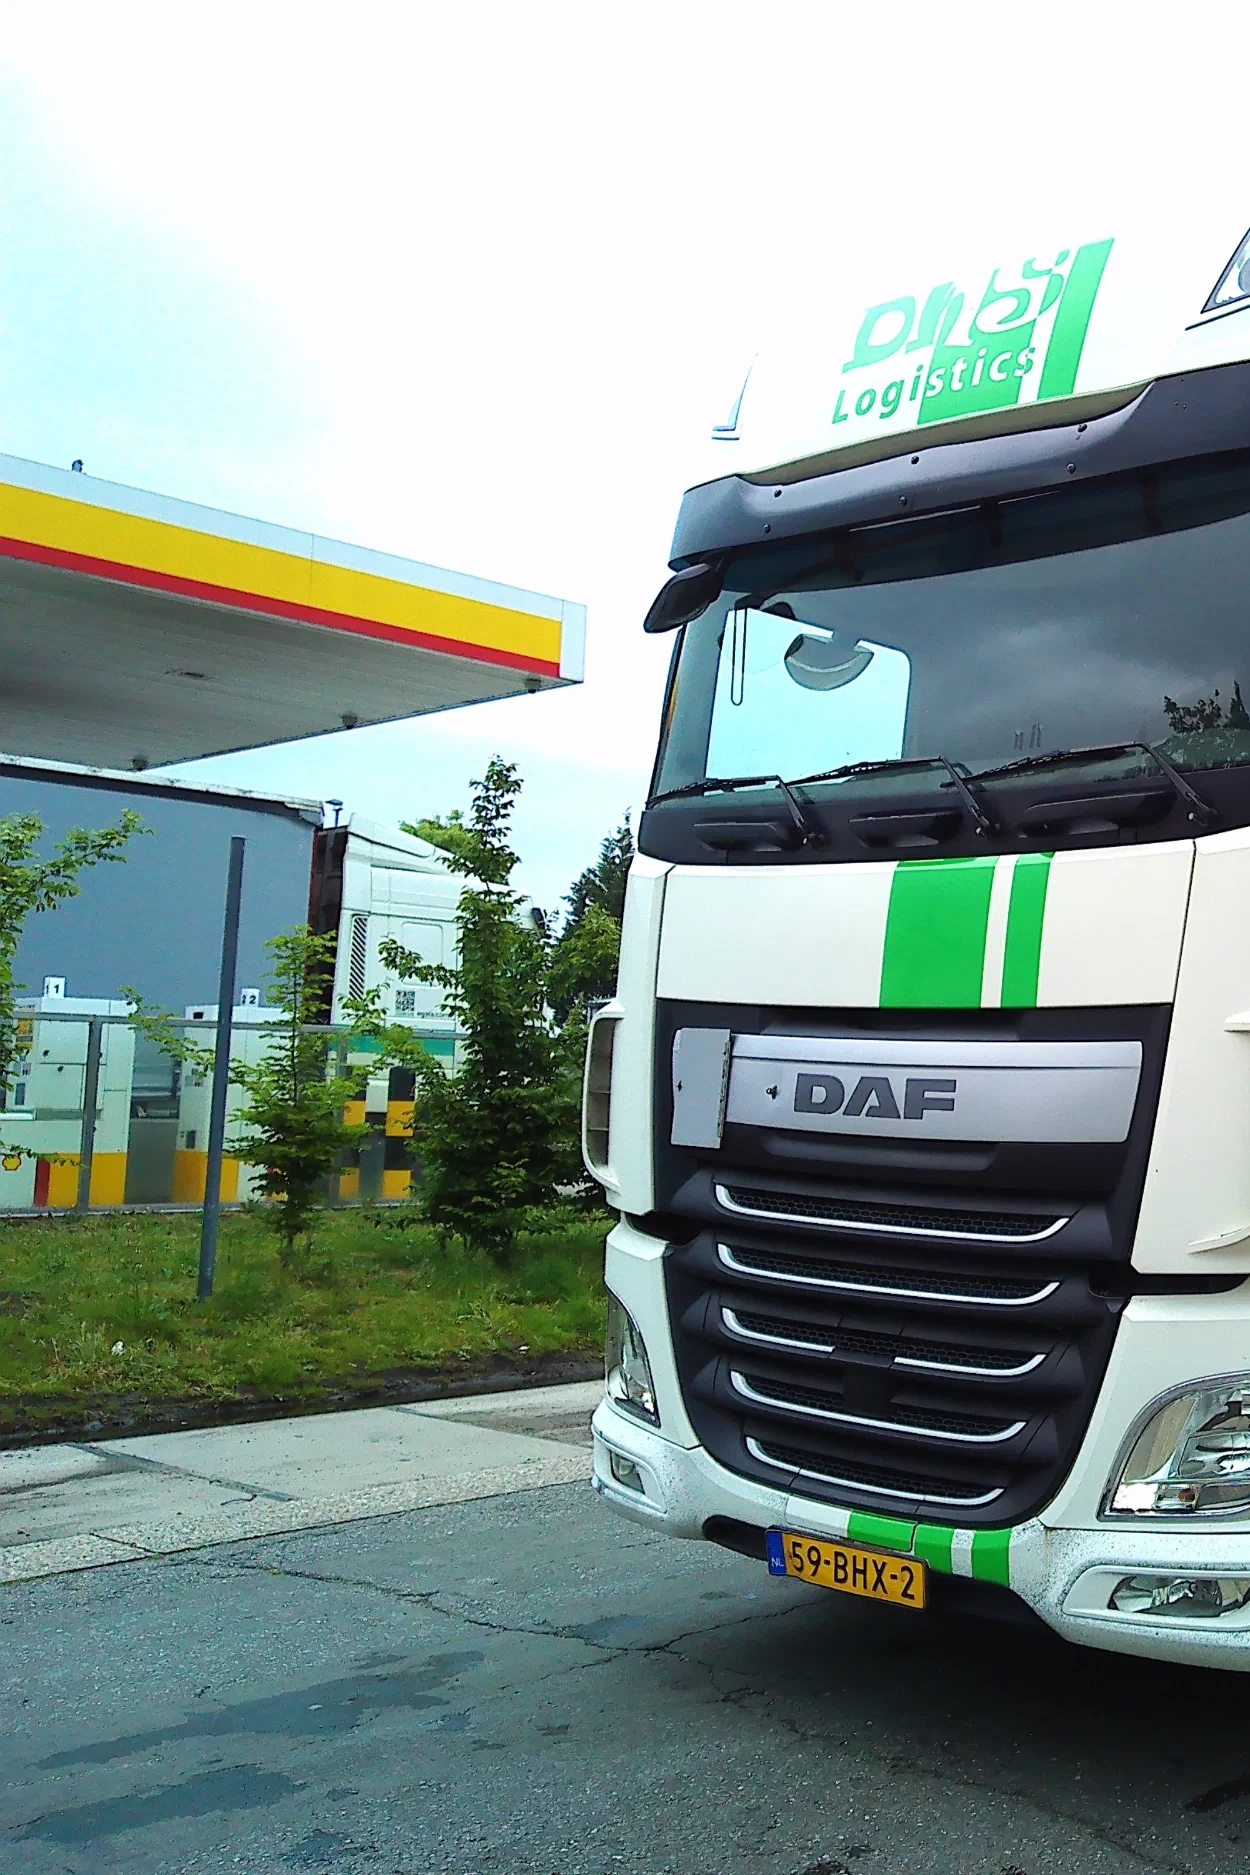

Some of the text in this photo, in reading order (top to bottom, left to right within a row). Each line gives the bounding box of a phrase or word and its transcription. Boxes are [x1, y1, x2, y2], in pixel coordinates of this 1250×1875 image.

[832, 347, 1035, 424] Logistics
[794, 1073, 956, 1119] DAF
[771, 1557, 784, 1567] NL
[791, 1541, 915, 1600] 59-BHX-2
